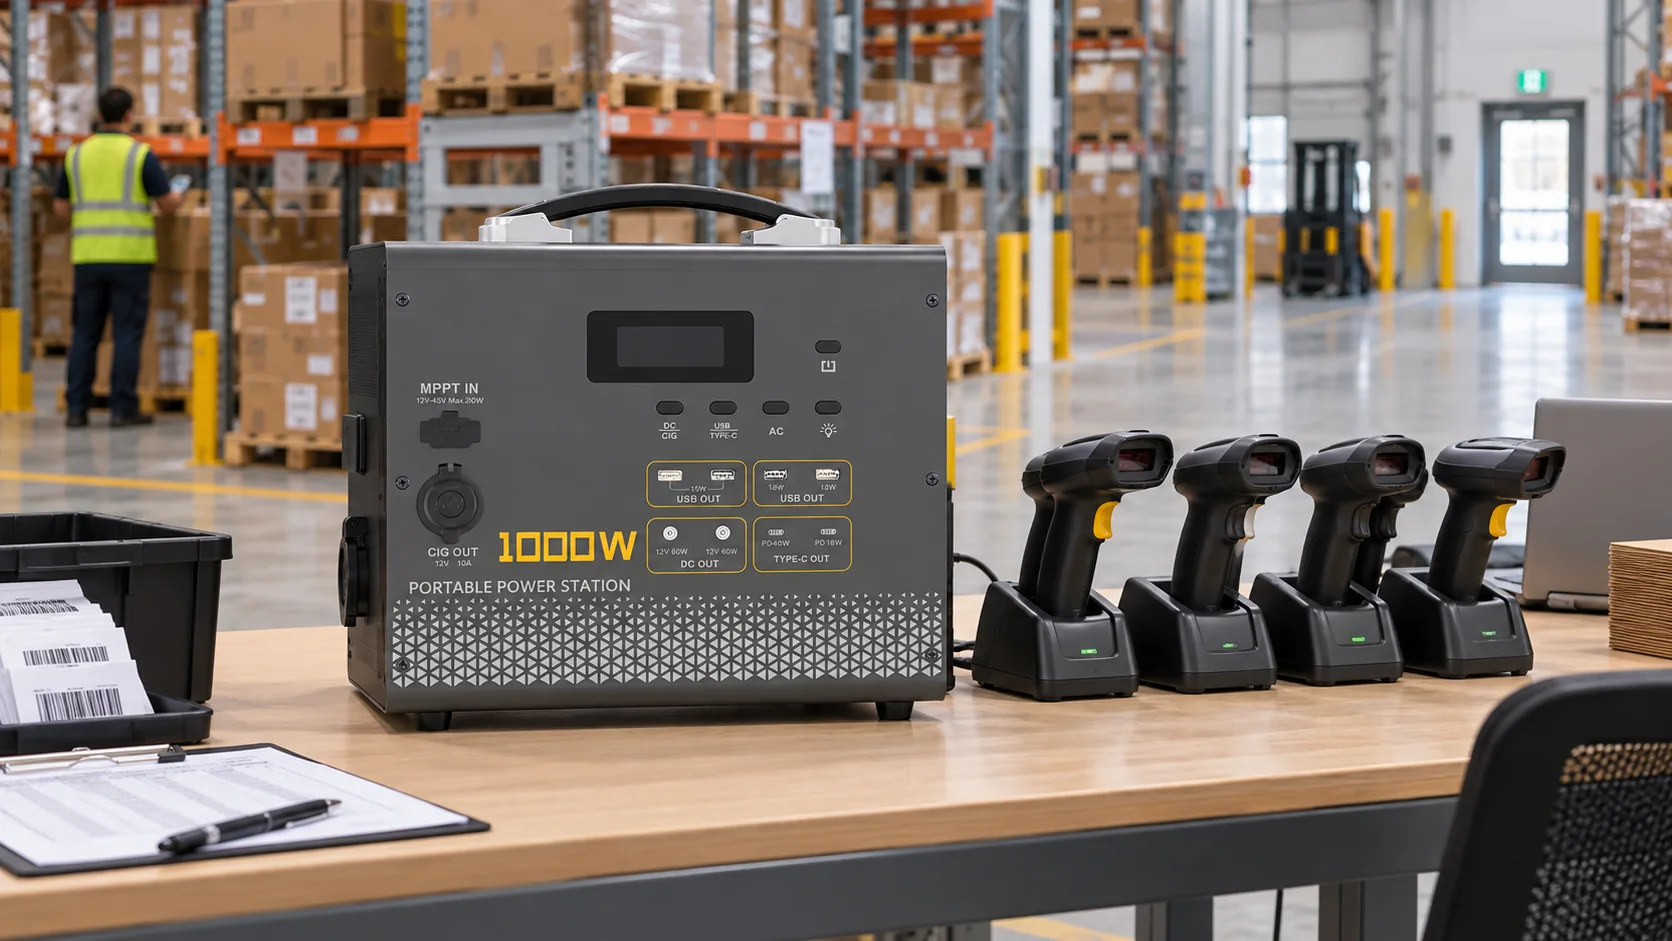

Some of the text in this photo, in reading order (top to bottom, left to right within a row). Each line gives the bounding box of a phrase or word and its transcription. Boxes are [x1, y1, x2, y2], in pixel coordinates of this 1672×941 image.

[420, 382, 478, 394] MPPT IN
[769, 427, 784, 435] AC
[676, 494, 721, 503] USB OUT
[780, 494, 824, 503] USB OUT
[498, 531, 637, 562] 1000W
[427, 547, 479, 557] CIG OUT
[774, 554, 830, 563] TYPE-C OUT
[680, 560, 719, 568] DC OUT
[409, 579, 631, 594] PORTABLE POWER STATION
